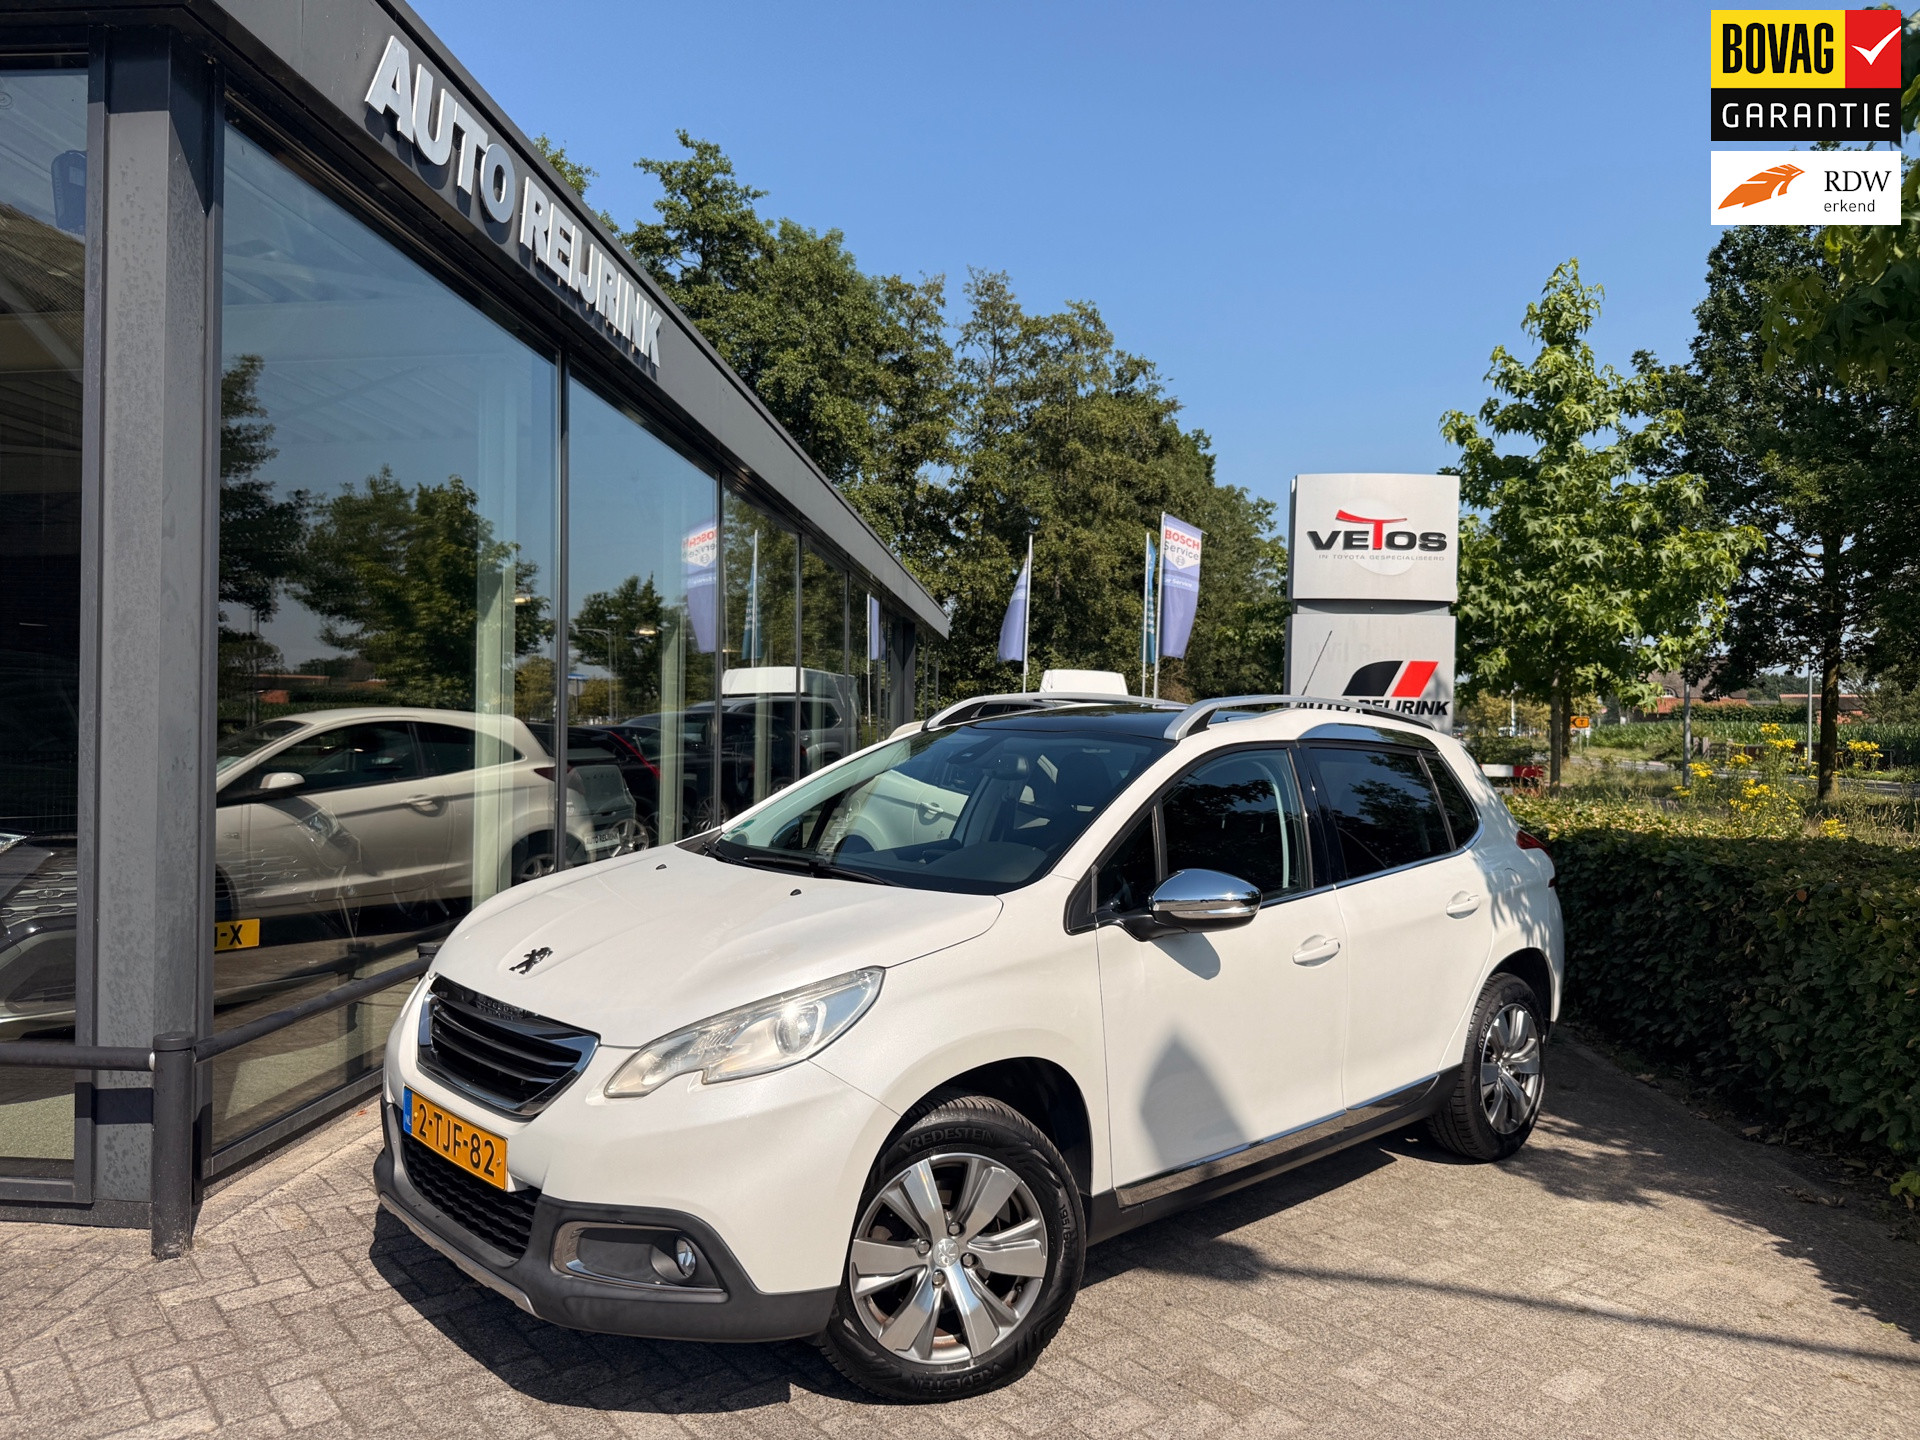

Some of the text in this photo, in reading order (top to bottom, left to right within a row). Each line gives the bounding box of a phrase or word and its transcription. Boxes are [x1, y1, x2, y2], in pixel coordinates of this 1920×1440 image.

[364, 34, 516, 224] AUTO
[1163, 540, 1200, 560] Service
[1164, 528, 1200, 550] BOSCH
[1306, 509, 1448, 552] VETOS
[419, 1103, 495, 1178] 2-TJF-82
